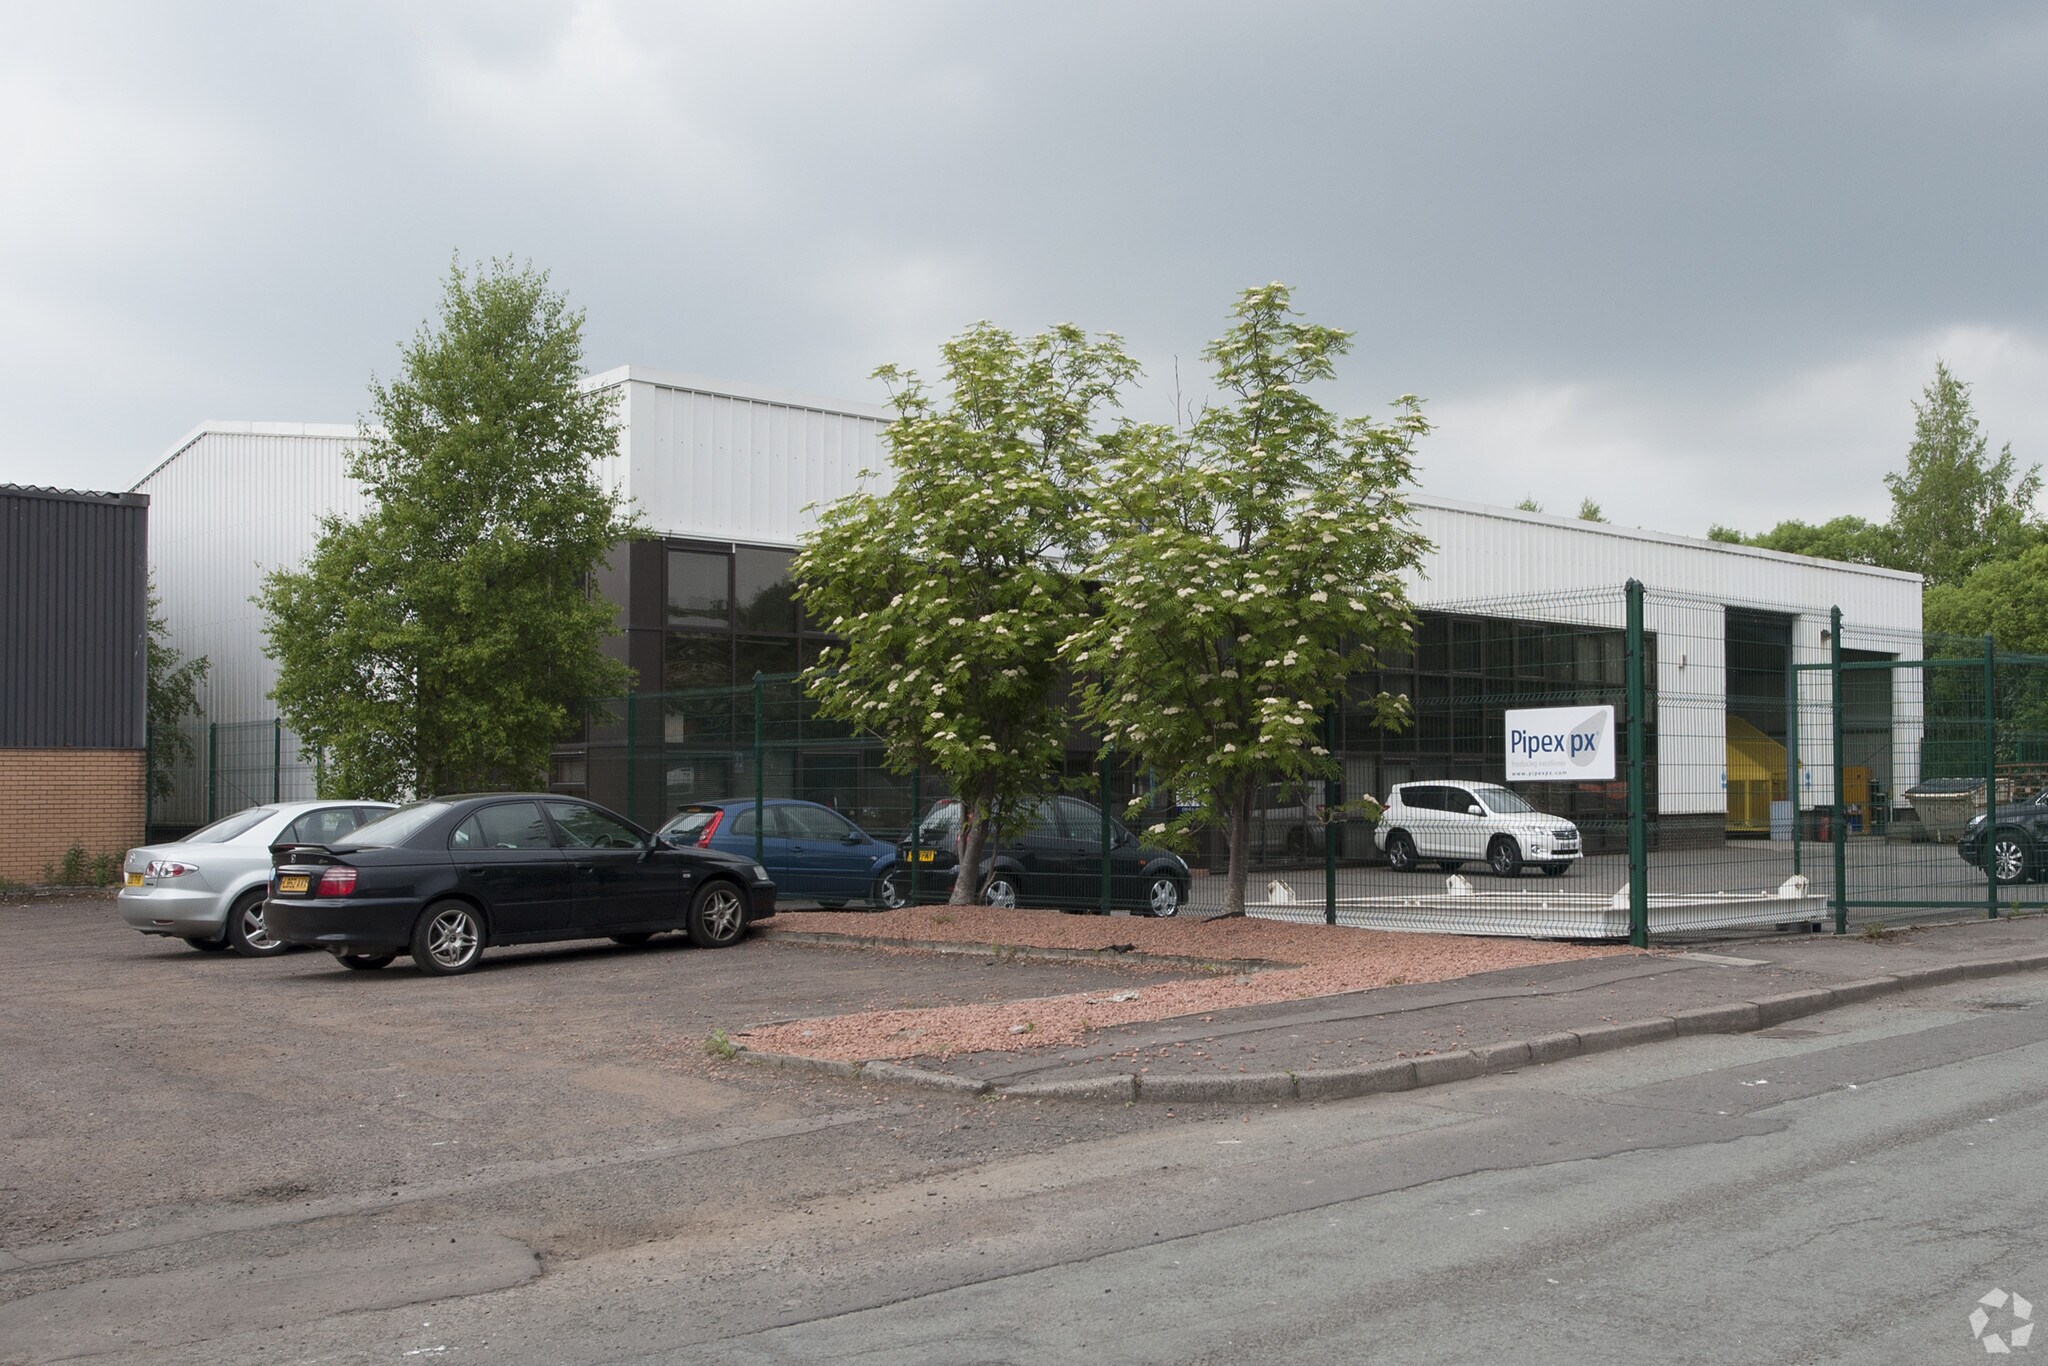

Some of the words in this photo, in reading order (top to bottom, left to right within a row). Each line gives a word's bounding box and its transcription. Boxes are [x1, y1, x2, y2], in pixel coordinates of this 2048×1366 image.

[1511, 730, 1565, 758] Pipex
[1571, 733, 1595, 758] px
[1511, 760, 1537, 768] Producing
